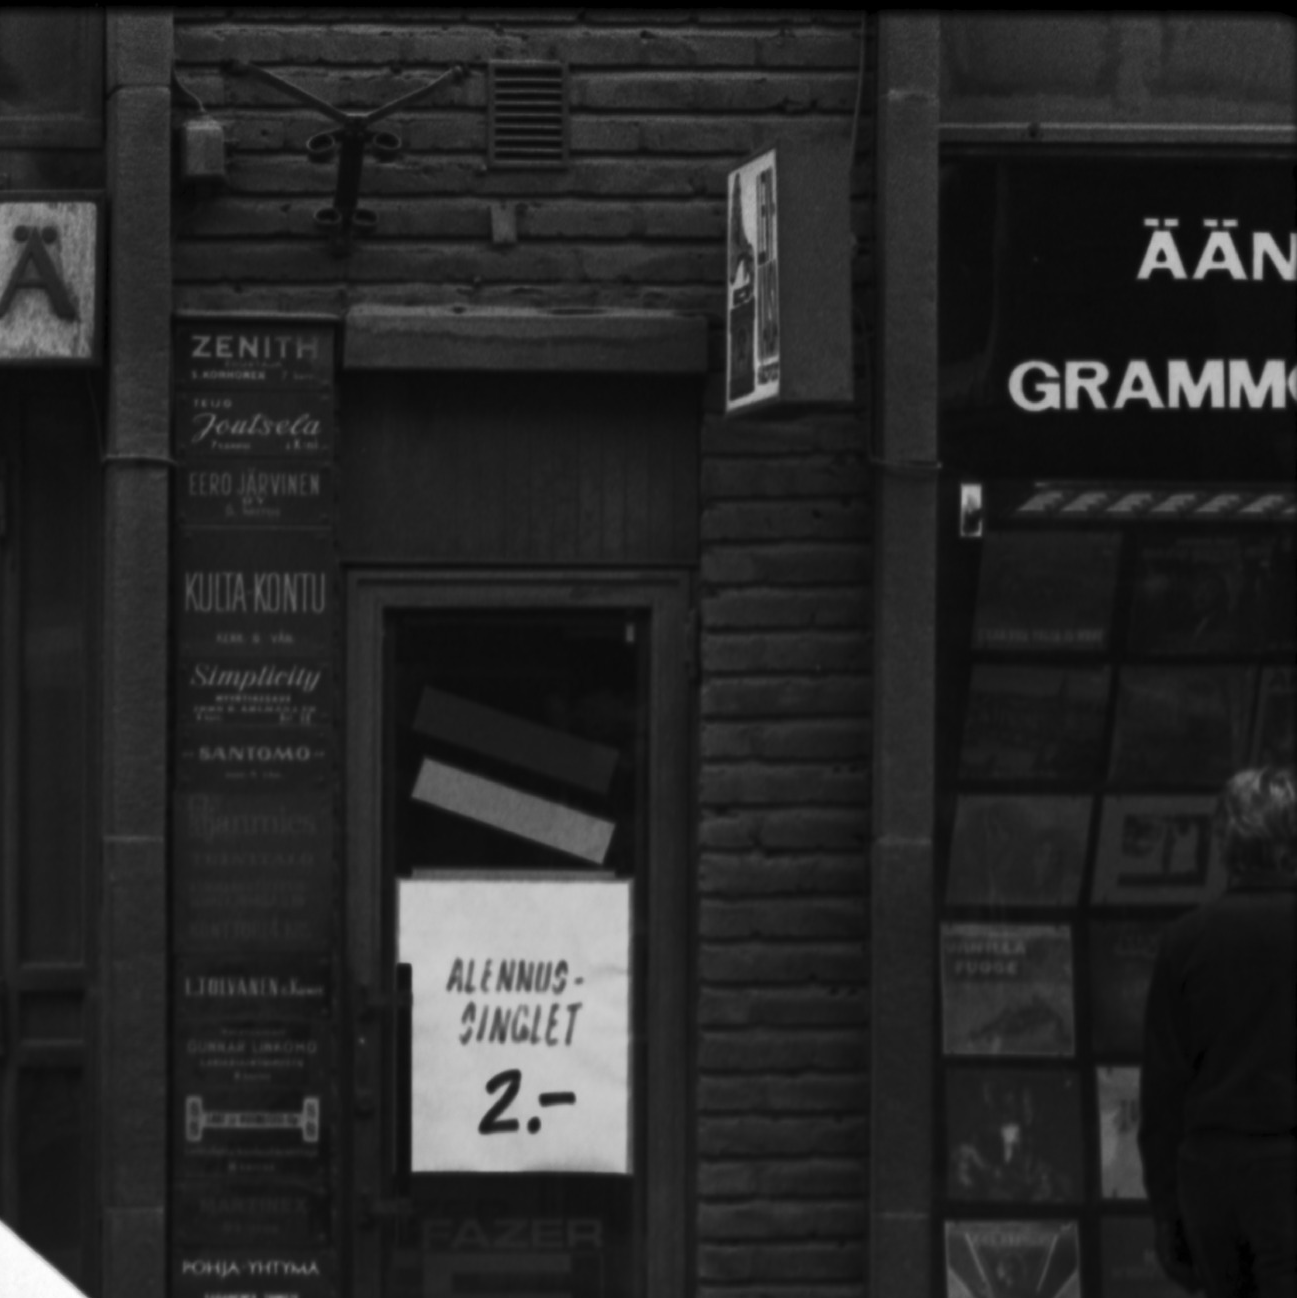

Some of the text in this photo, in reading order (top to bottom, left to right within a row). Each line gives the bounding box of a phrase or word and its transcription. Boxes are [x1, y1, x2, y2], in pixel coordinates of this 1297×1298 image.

[191, 335, 319, 359] ZENITH
[1007, 358, 1296, 413] GRAMM
[191, 412, 321, 443] Joutsela
[189, 466, 320, 496] EERO JÄRVINEN
[190, 662, 321, 692] Simplicity
[198, 746, 311, 761] SANTOMO
[446, 956, 584, 996] ALENNUS-
[458, 1000, 583, 1047] SINGLET
[423, 1218, 604, 1248] FAZER
